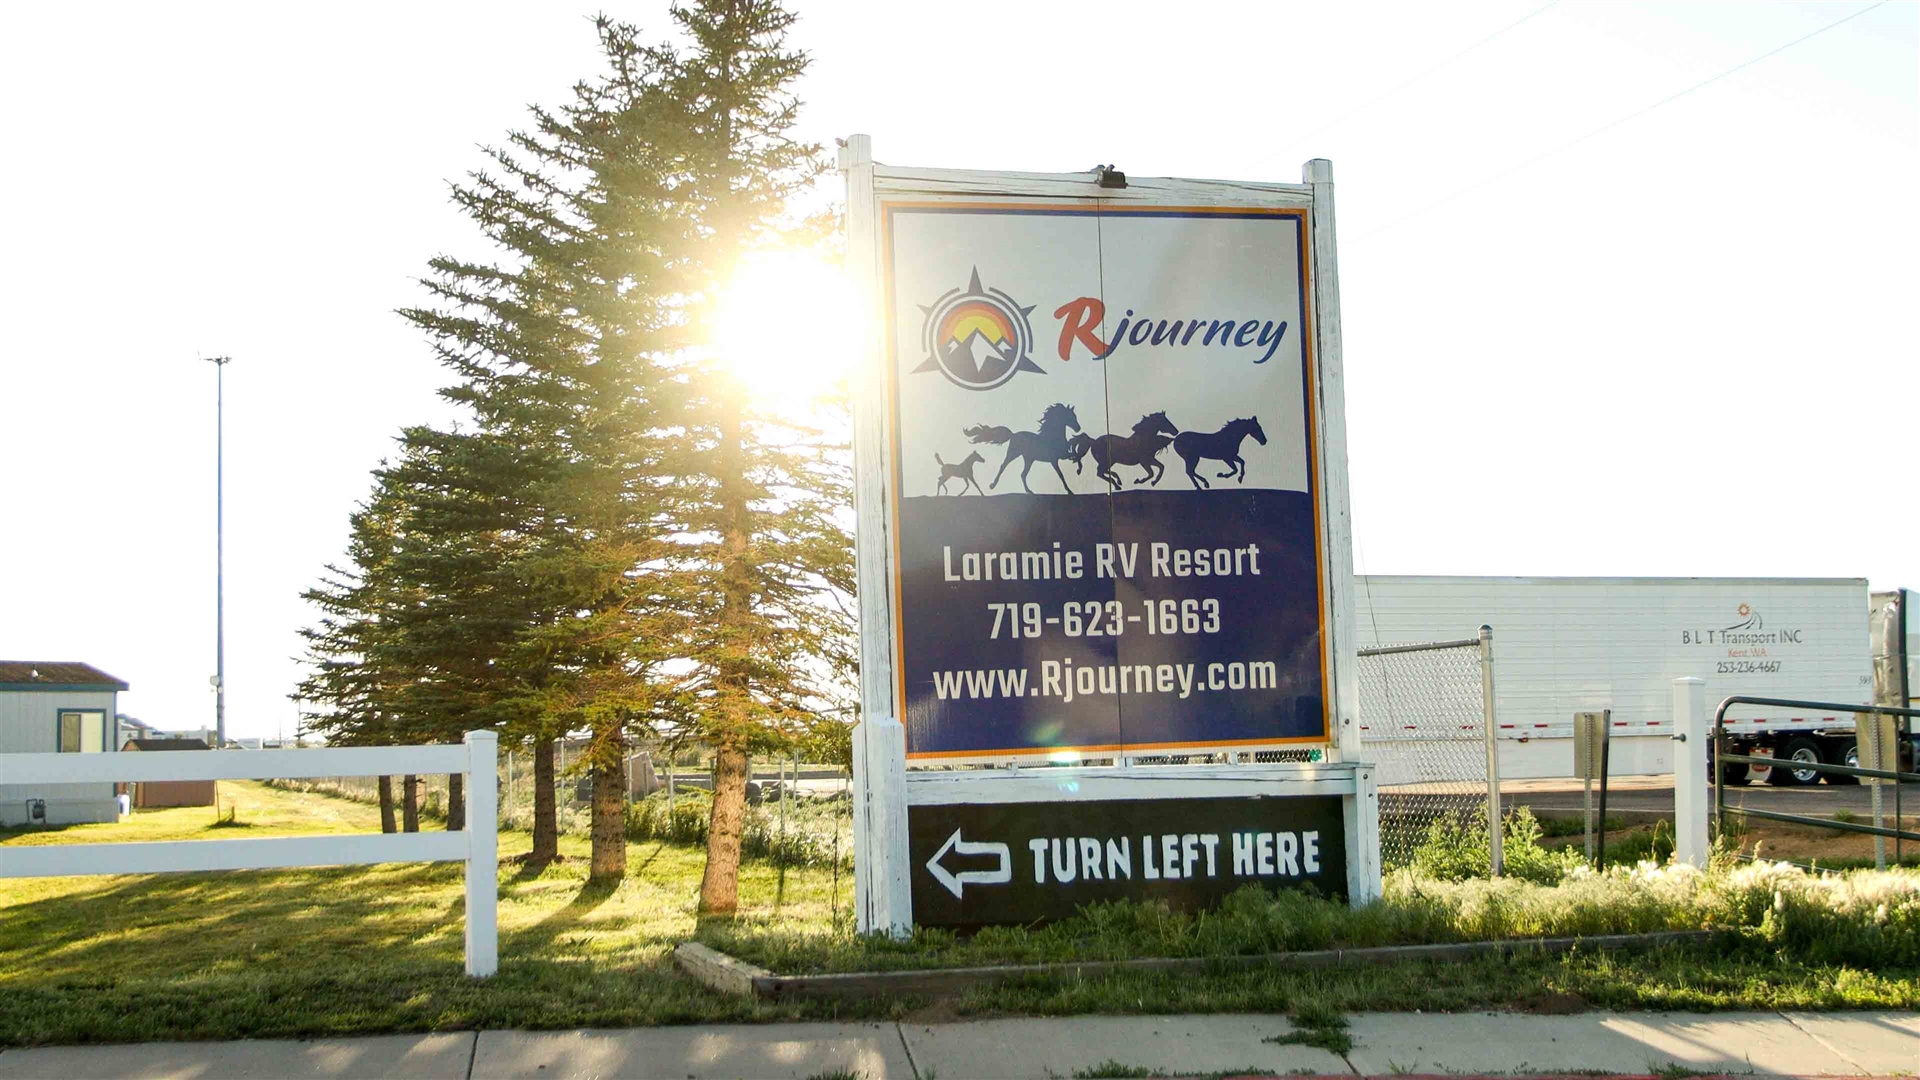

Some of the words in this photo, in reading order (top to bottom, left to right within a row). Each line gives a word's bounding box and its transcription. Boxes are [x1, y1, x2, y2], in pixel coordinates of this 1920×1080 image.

[1053, 296, 1288, 365] Rjourney
[943, 541, 1083, 583] Laramie
[1095, 542, 1139, 579] RV
[1150, 542, 1261, 577] Resort
[986, 597, 1221, 641] 719-623-1663
[1719, 630, 1777, 647] Transport
[1779, 629, 1803, 644] INC
[932, 656, 1277, 703] www.Rjourney.com
[1717, 660, 1782, 674] 253-236-4667
[1028, 836, 1132, 885] TURN
[1142, 832, 1220, 881] LEFT
[1231, 830, 1321, 878] HERE
